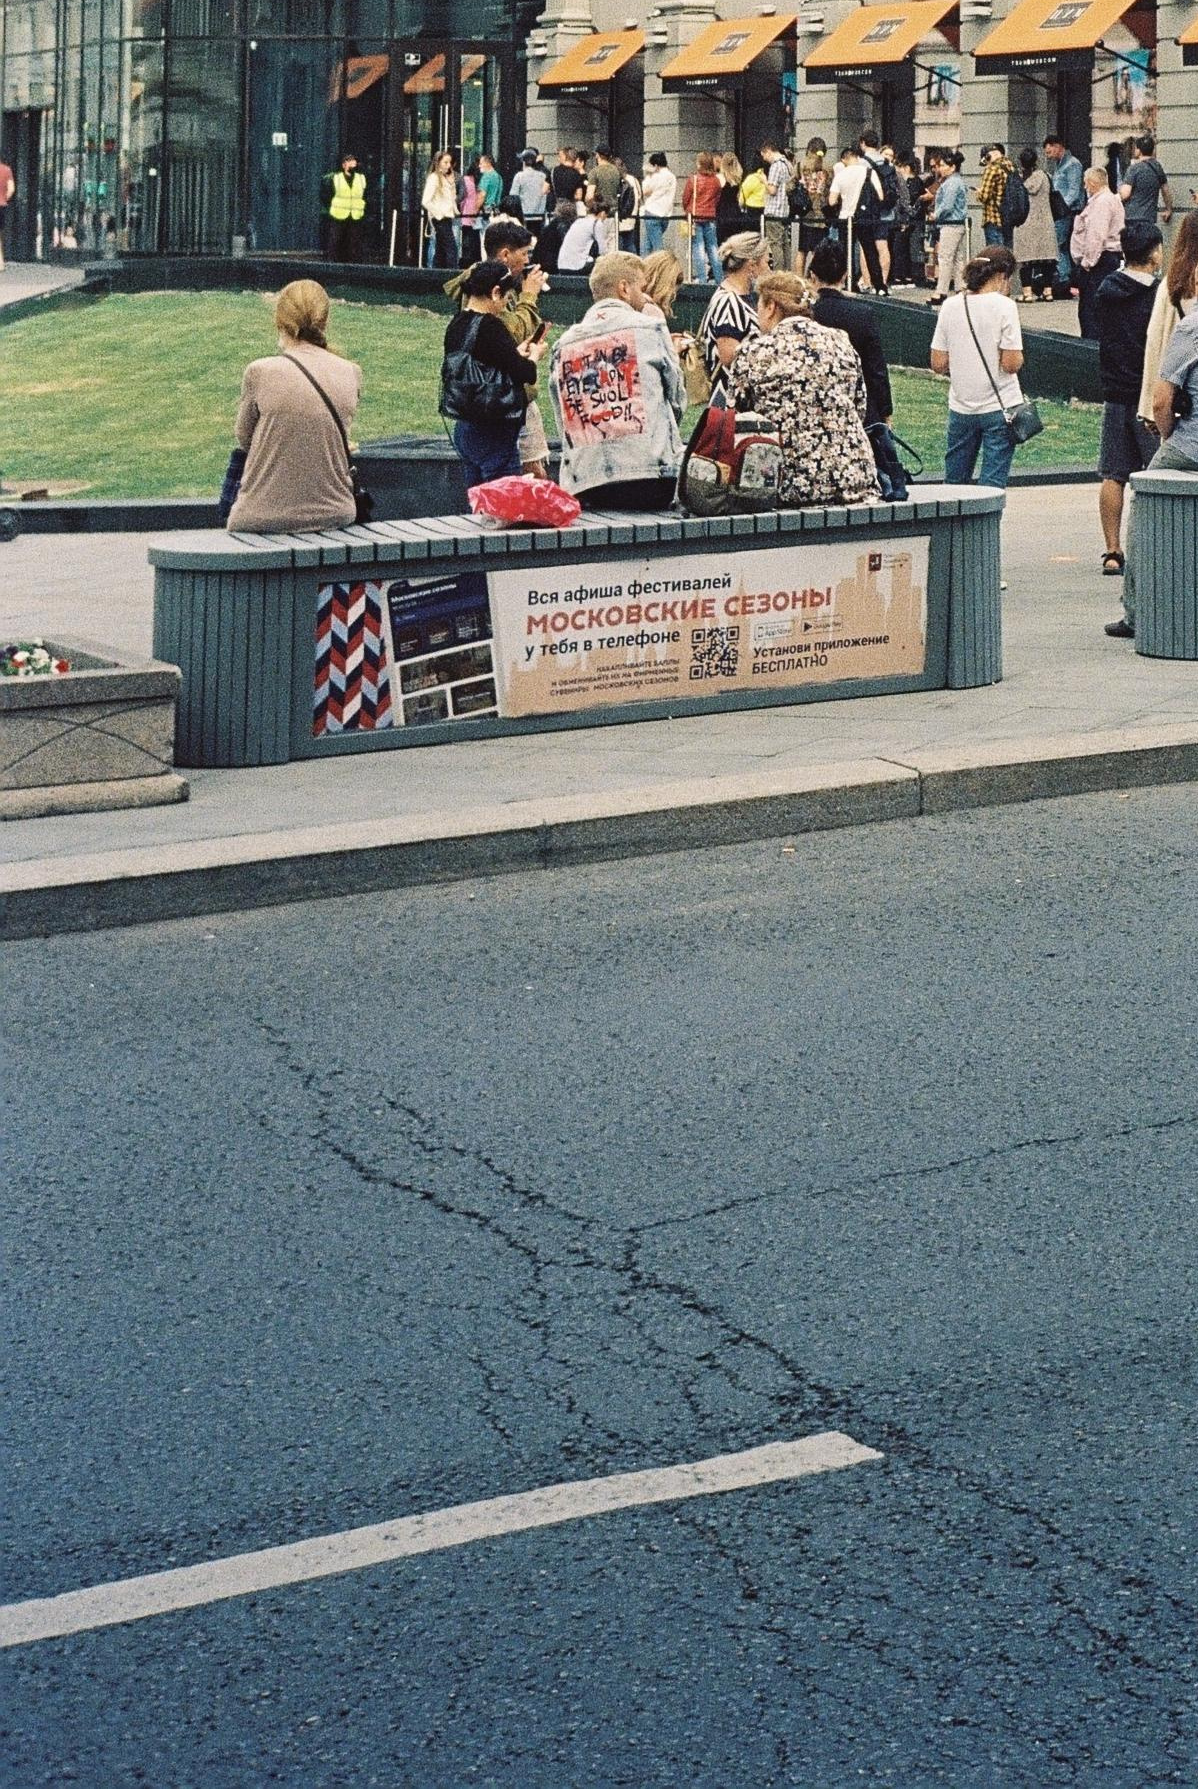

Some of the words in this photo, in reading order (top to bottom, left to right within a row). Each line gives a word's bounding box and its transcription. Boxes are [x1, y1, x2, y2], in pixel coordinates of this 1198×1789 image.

[528, 590, 559, 605] Вся
[563, 585, 623, 604] афиша
[627, 573, 732, 598] фестивалей
[526, 598, 717, 635] МОСКОВСКИЕ
[723, 587, 832, 617] СЕЗОНЫ
[525, 644, 535, 661] у
[539, 638, 578, 657] тебя
[583, 639, 593, 651] в
[599, 629, 681, 650] телефоне
[752, 642, 811, 659] Установи
[814, 634, 890, 652] приложение
[752, 654, 829, 675] БЕСПЛАТНО
